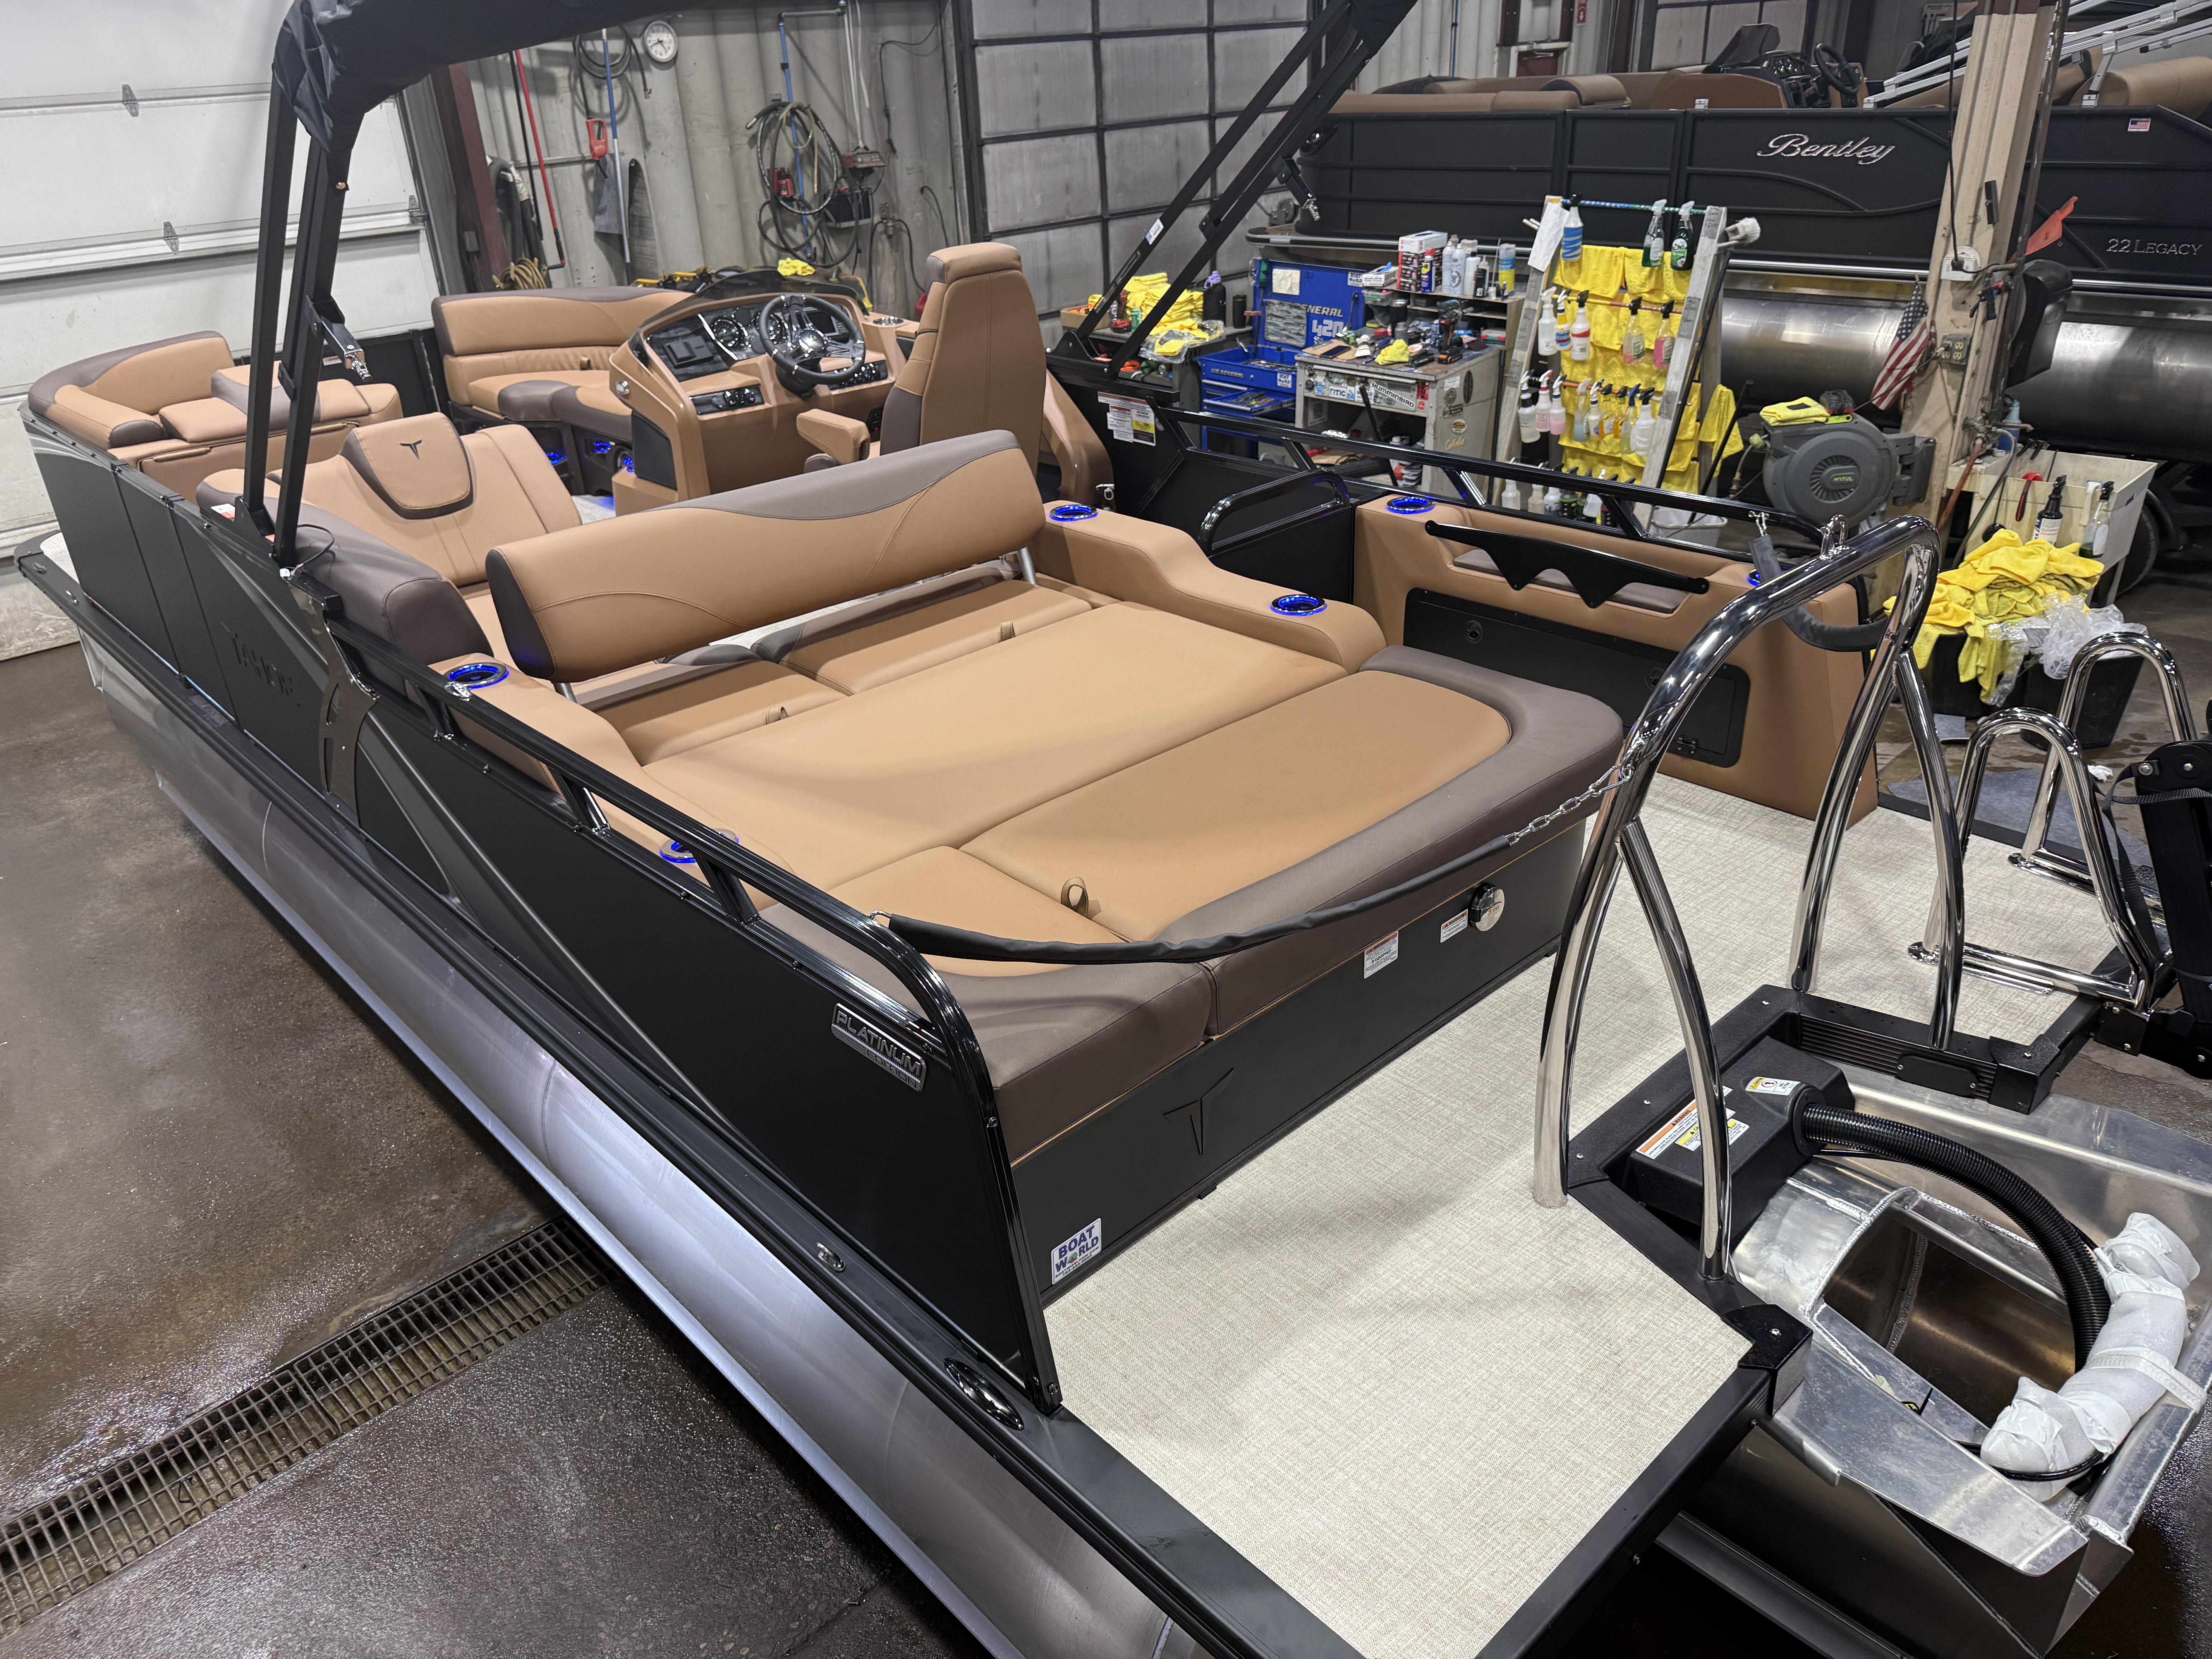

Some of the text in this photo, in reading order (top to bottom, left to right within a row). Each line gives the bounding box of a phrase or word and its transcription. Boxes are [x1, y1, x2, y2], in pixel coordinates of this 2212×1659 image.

[1757, 133, 1896, 165] Bentley
[2106, 238, 2203, 255] 22 LEGACY
[1302, 304, 1344, 318] ENERAL
[1329, 388, 1346, 397] RTIC
[1372, 383, 1414, 407] HUMMINBIRD
[836, 1010, 921, 1076] PLATINUM
[867, 1050, 917, 1089] EDITION
[1058, 1225, 1095, 1260] BOAT
